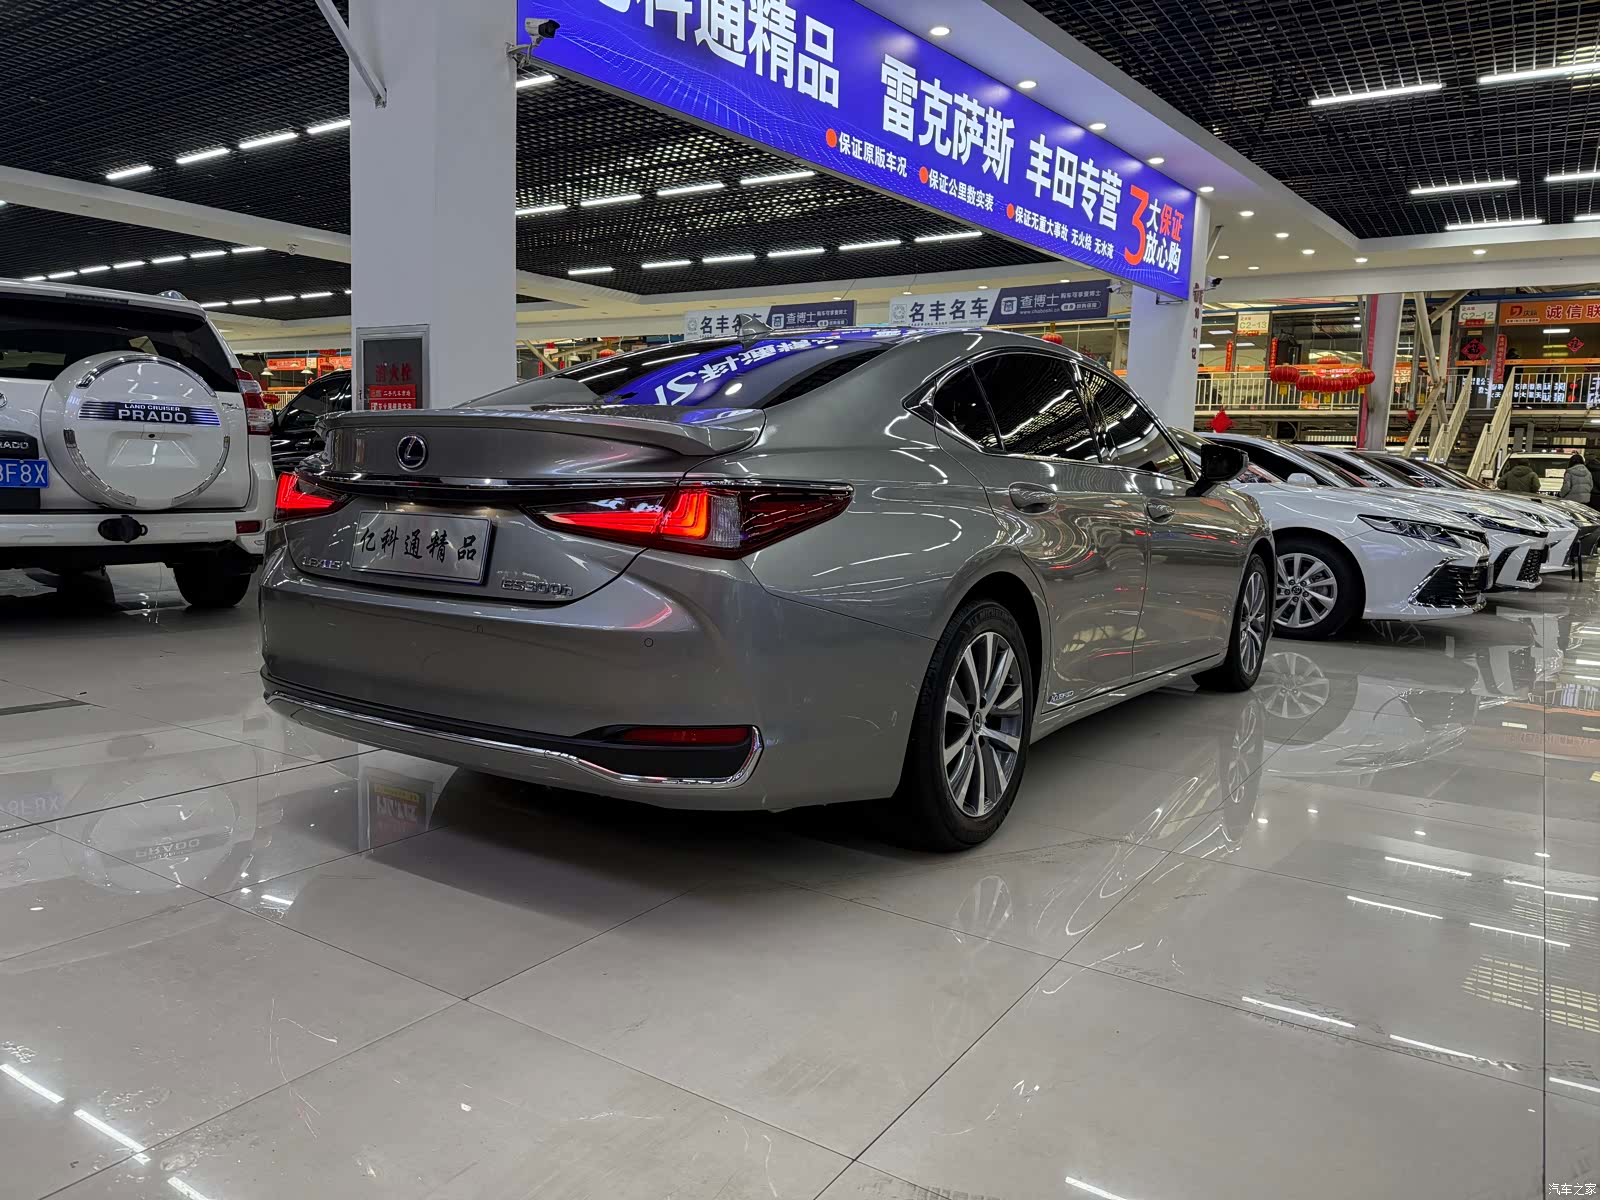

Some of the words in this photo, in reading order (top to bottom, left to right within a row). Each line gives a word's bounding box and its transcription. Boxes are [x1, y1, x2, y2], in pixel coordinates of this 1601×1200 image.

[599, 0, 839, 108] 通精品
[881, 54, 1015, 184] 雷克萨斯
[1025, 134, 1122, 231] 丰田专营
[838, 131, 908, 178] 保证原版车况
[928, 168, 995, 212] 保证公里数实表
[1015, 205, 1069, 242] 保证无重大事故
[1071, 228, 1092, 251] 无火烧
[1124, 184, 1149, 266] 3
[1143, 231, 1182, 274] 放心购
[786, 311, 816, 325] 查博士
[908, 297, 988, 322] 名丰名车
[1020, 293, 1060, 309] 查博士
[1239, 321, 1268, 330] C2-13
[118, 409, 187, 423] PRADO
[147, 404, 181, 412] CRUISER
[360, 525, 478, 563] 亿科通精品
